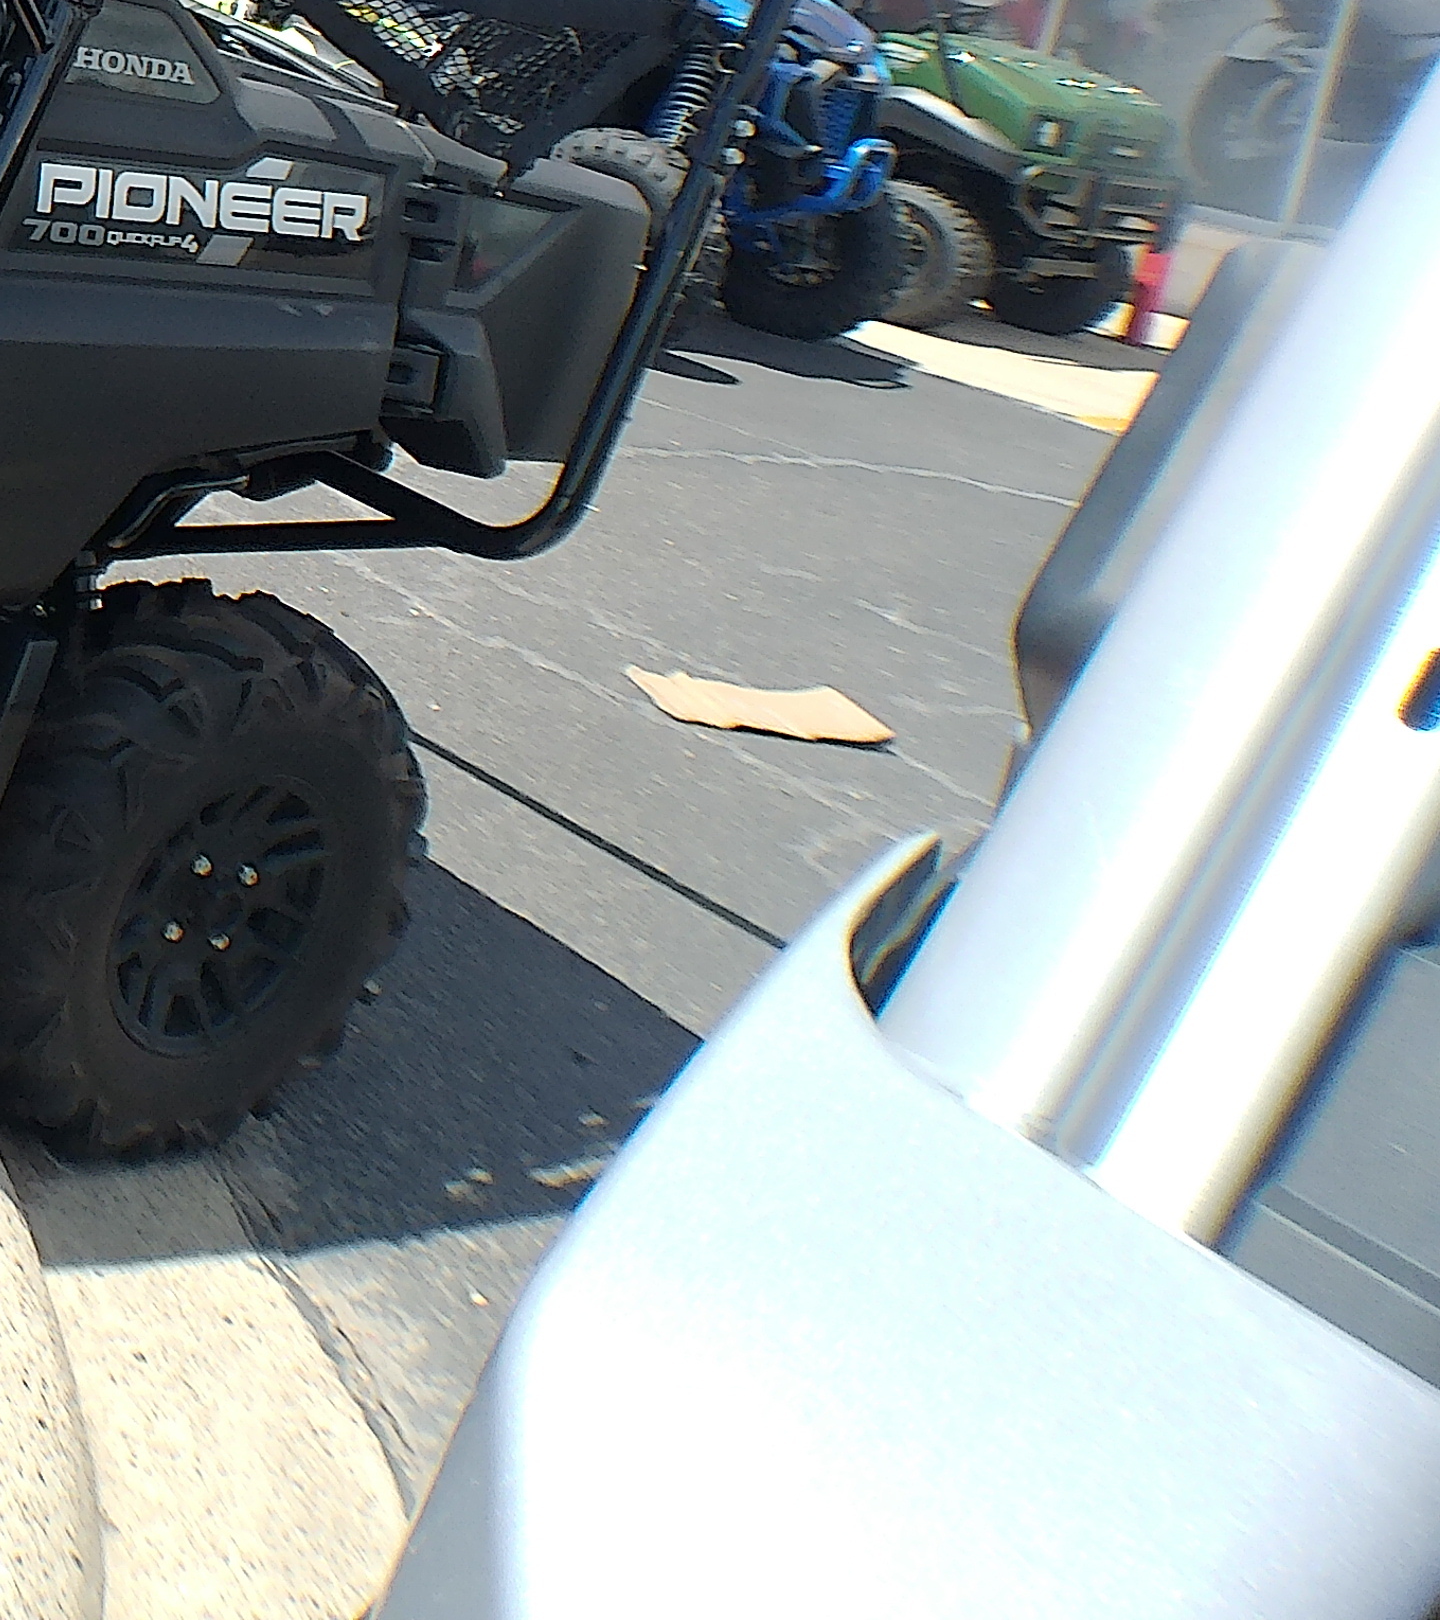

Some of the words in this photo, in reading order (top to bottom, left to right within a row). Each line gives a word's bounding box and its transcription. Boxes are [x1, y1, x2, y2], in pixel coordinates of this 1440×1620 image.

[72, 46, 195, 85] HONDA
[35, 162, 369, 242] PIONEER
[22, 217, 106, 246] 700
